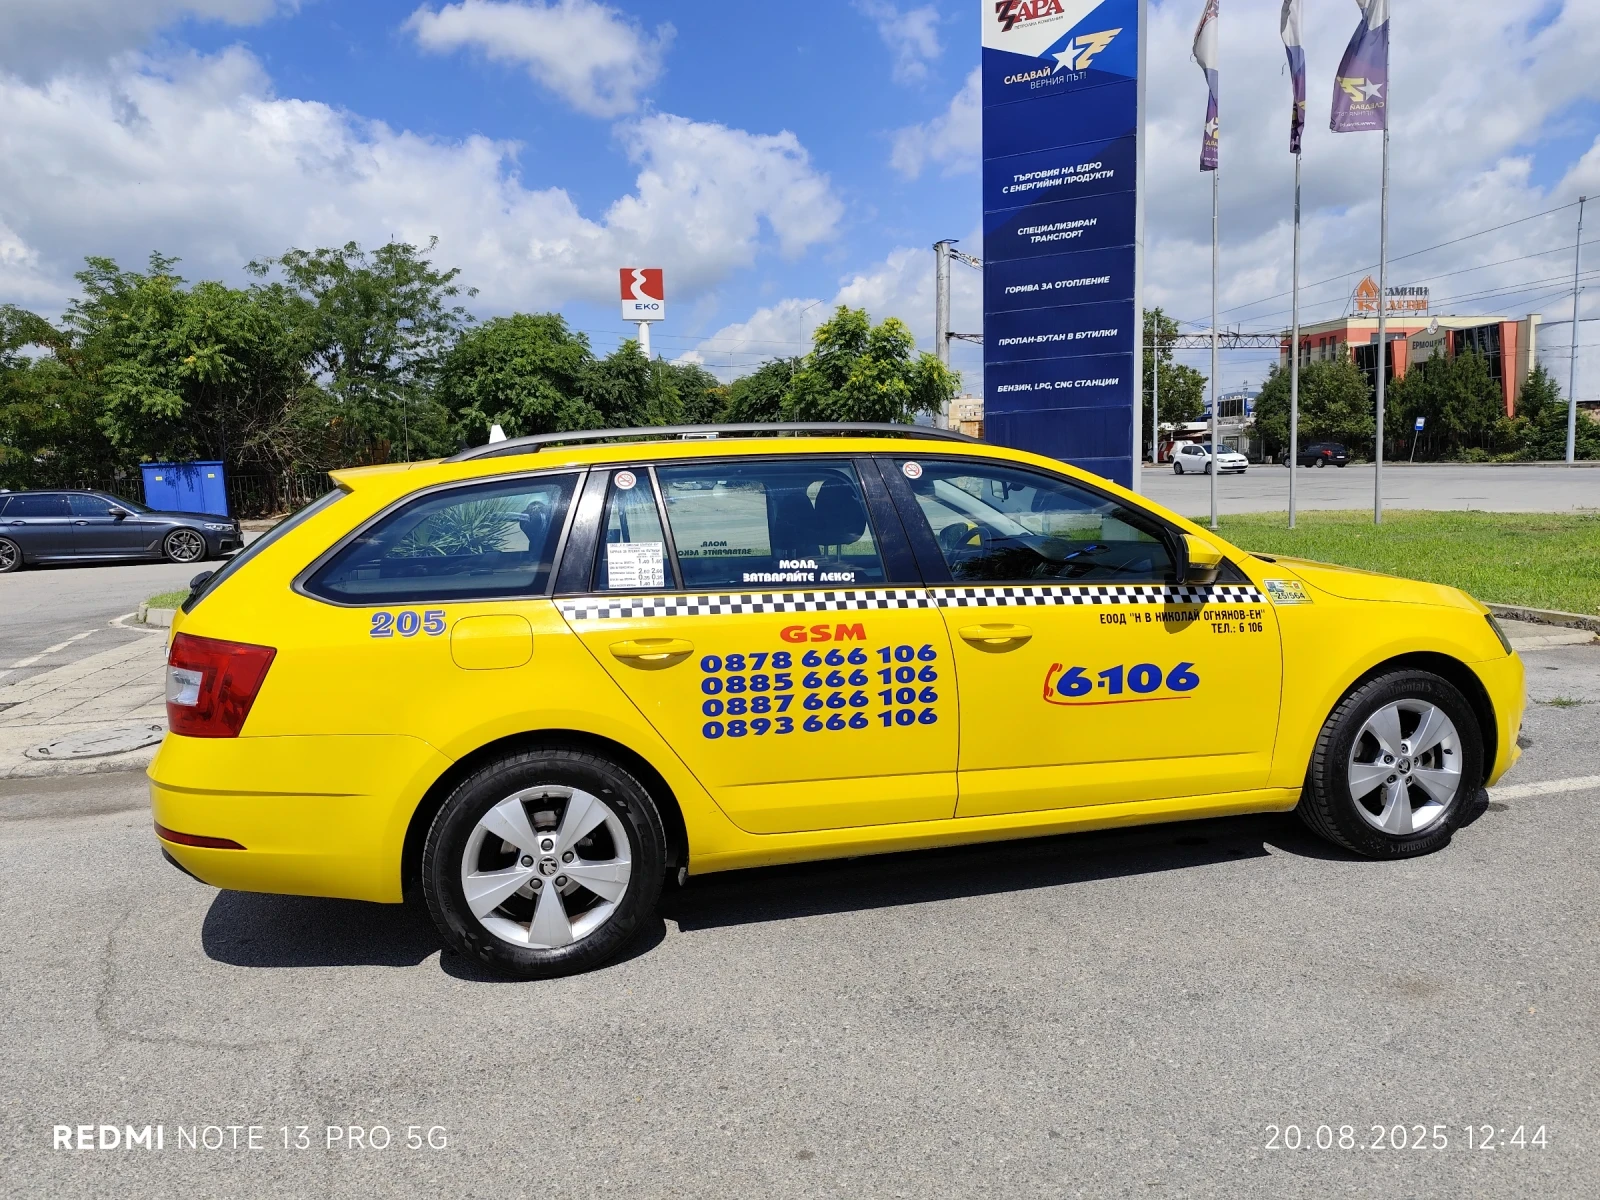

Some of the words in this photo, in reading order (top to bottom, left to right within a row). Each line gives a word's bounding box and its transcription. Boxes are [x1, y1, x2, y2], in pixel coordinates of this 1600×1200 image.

[1003, 66, 1051, 85] СЛЕДВАЙ
[1030, 75, 1065, 90] ВЕРНИЯ
[1066, 71, 1087, 83] ПЪТ!
[1002, 186, 1009, 194] С
[1010, 177, 1063, 193] ЕНЕРГИЙНИ
[1064, 169, 1115, 185] ПРОДУКТИ
[1013, 168, 1060, 183] ТЪРГОВИЯ
[1061, 166, 1075, 175] НА
[1076, 161, 1102, 173] ЕДРО
[1017, 218, 1098, 236] СПЕЦИАЛИЗИРАН
[1030, 230, 1084, 244] ТРАНСПОРТ
[1005, 284, 1040, 295] ГОРИВА
[1041, 282, 1053, 291] ЗА
[1054, 275, 1111, 289] ОТОПЛЕНИЕ
[635, 303, 660, 311] EKO
[998, 334, 1066, 346] ПРОПАН-БУТАН
[1067, 332, 1074, 340] В
[1075, 328, 1118, 340] БУТИЛКИ
[997, 383, 1033, 393] БЕНЗИН,
[1034, 382, 1053, 391] LPG,
[1054, 381, 1073, 389] CNG
[1074, 377, 1119, 387] СТАНЦИИ
[820, 572, 856, 583] ЛЕКО!
[369, 610, 447, 639] 205
[1100, 613, 1127, 625] ЕООД
[1145, 612, 1152, 622] В
[1155, 609, 1200, 622] НИКОЛАЙ
[1204, 609, 1266, 621] ОГНЯНОВ-ЕН"
[779, 623, 867, 643] GSM
[1211, 623, 1236, 634] ТЕЛ.:
[1239, 623, 1245, 632] 6
[1248, 622, 1263, 632] 106
[700, 651, 793, 673] 0878
[801, 647, 868, 668] 666
[876, 644, 938, 664] 106
[701, 672, 794, 695] 0885
[802, 668, 869, 689] 666
[877, 665, 938, 685] 106
[701, 694, 795, 717] 0887
[802, 689, 869, 711] 666
[877, 686, 939, 706] 106
[702, 716, 795, 739] 0893
[802, 711, 869, 733] 666
[877, 707, 939, 728] 106
